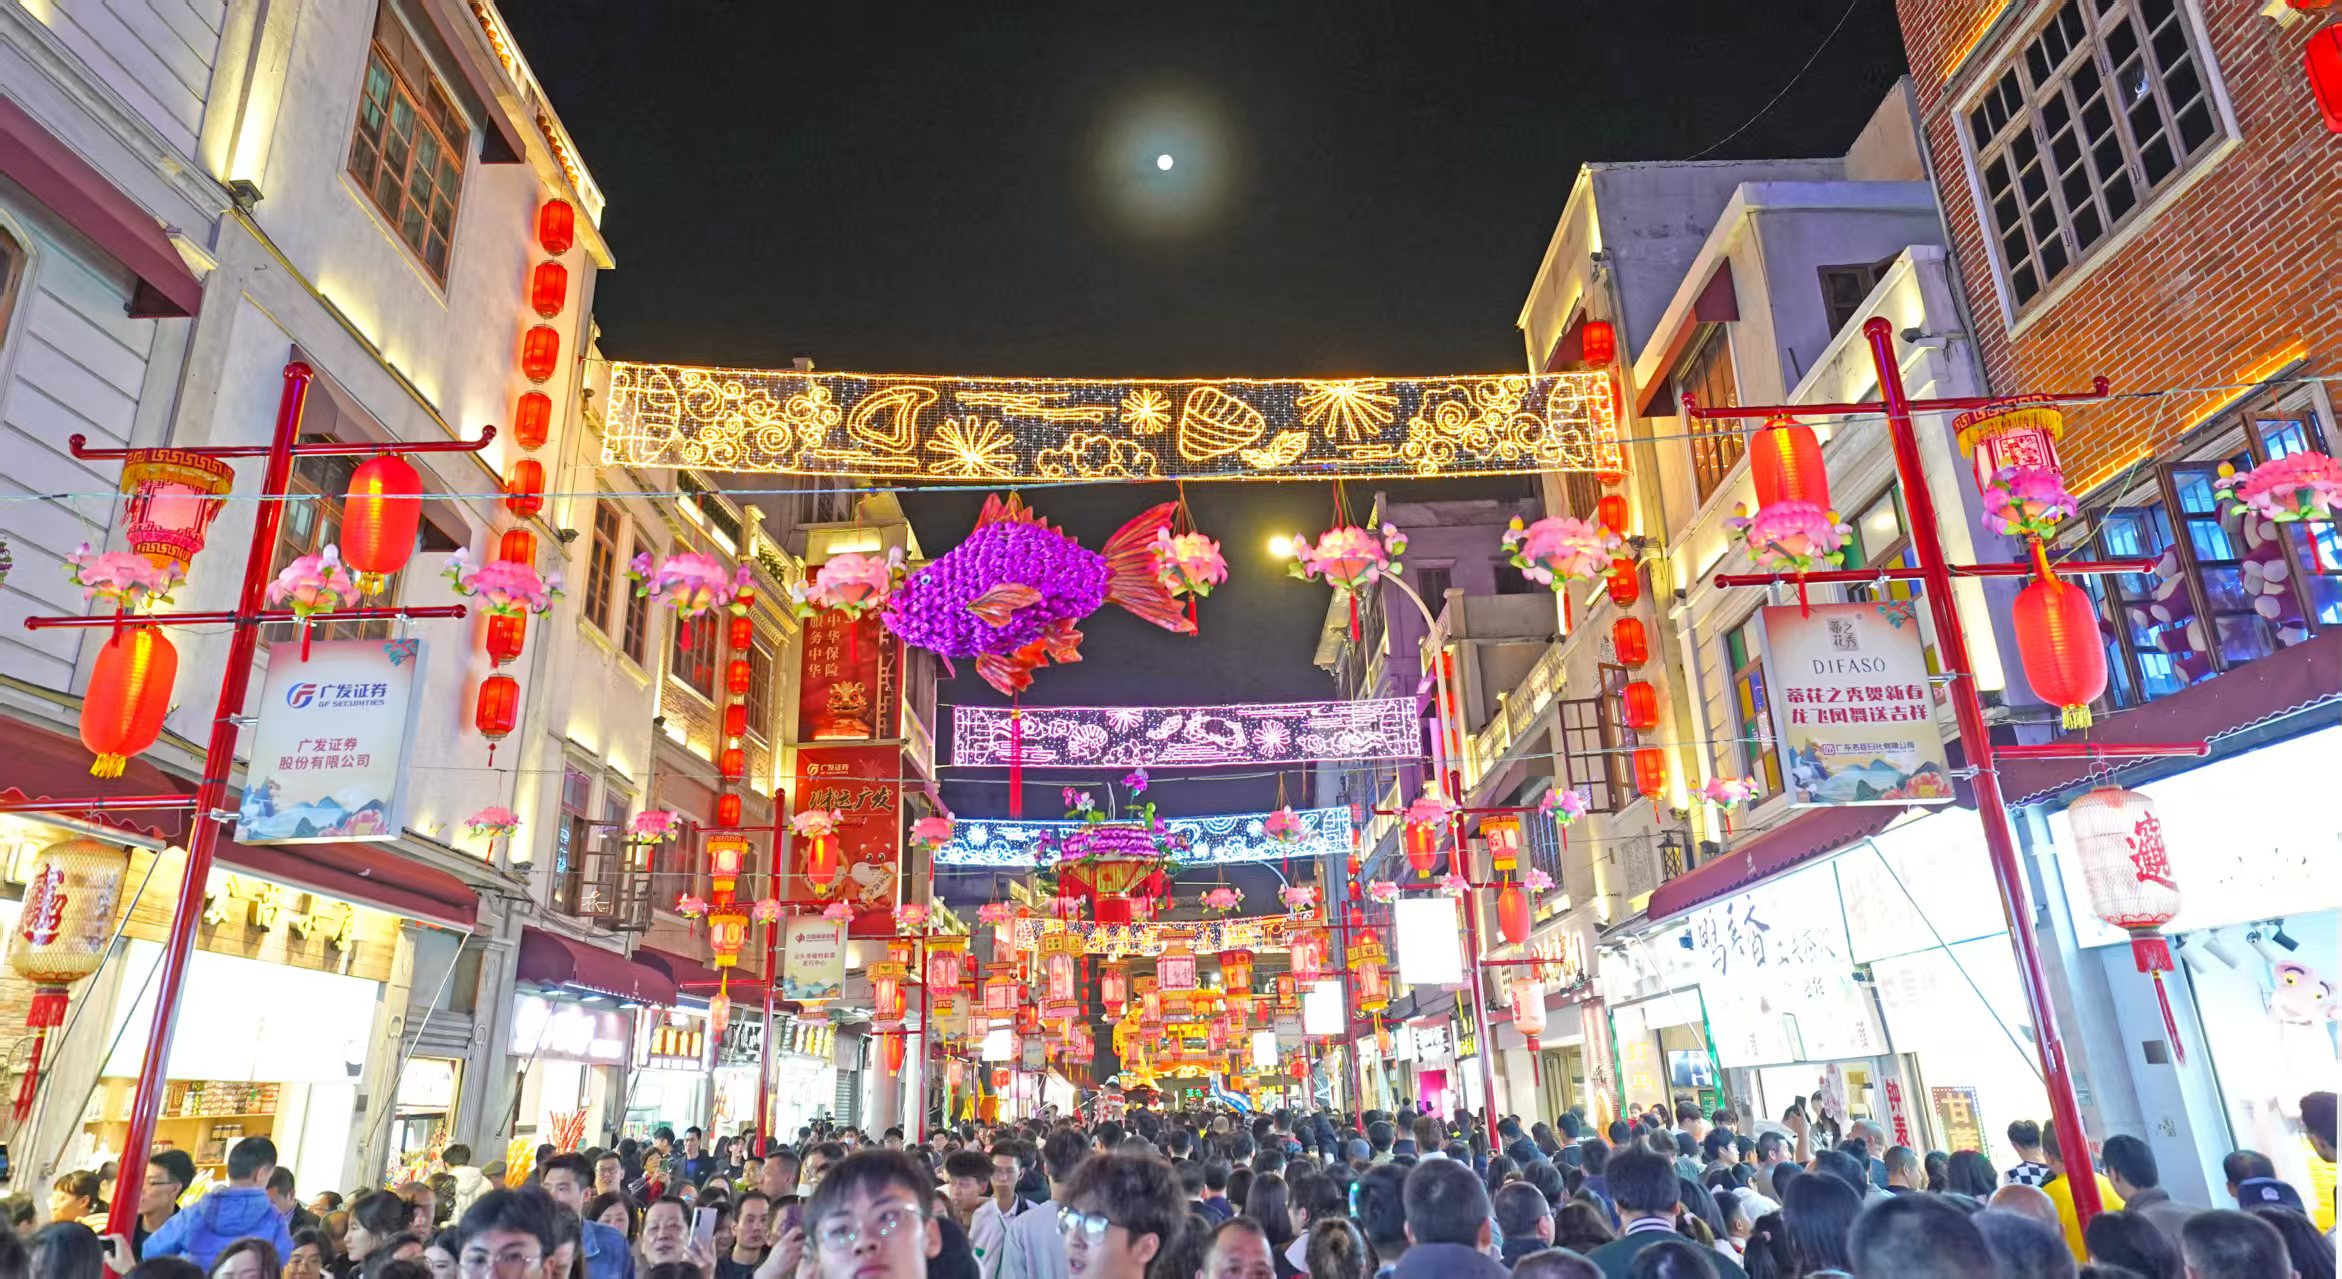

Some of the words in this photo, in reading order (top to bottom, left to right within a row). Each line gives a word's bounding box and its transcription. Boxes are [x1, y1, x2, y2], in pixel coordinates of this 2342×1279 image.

[824, 613, 841, 678] 中华保险
[1813, 657, 1885, 674] DIFASO
[319, 683, 387, 699] 广发证券
[1786, 685, 1924, 703] 蒂花之秀贺新春
[1791, 704, 1929, 724] 龙飞凤舞送吉祥
[297, 736, 358, 753] 广发证券
[278, 754, 371, 771] 股份有限公司
[820, 763, 849, 771] 广发证券
[1884, 1079, 1911, 1147] 钟表
